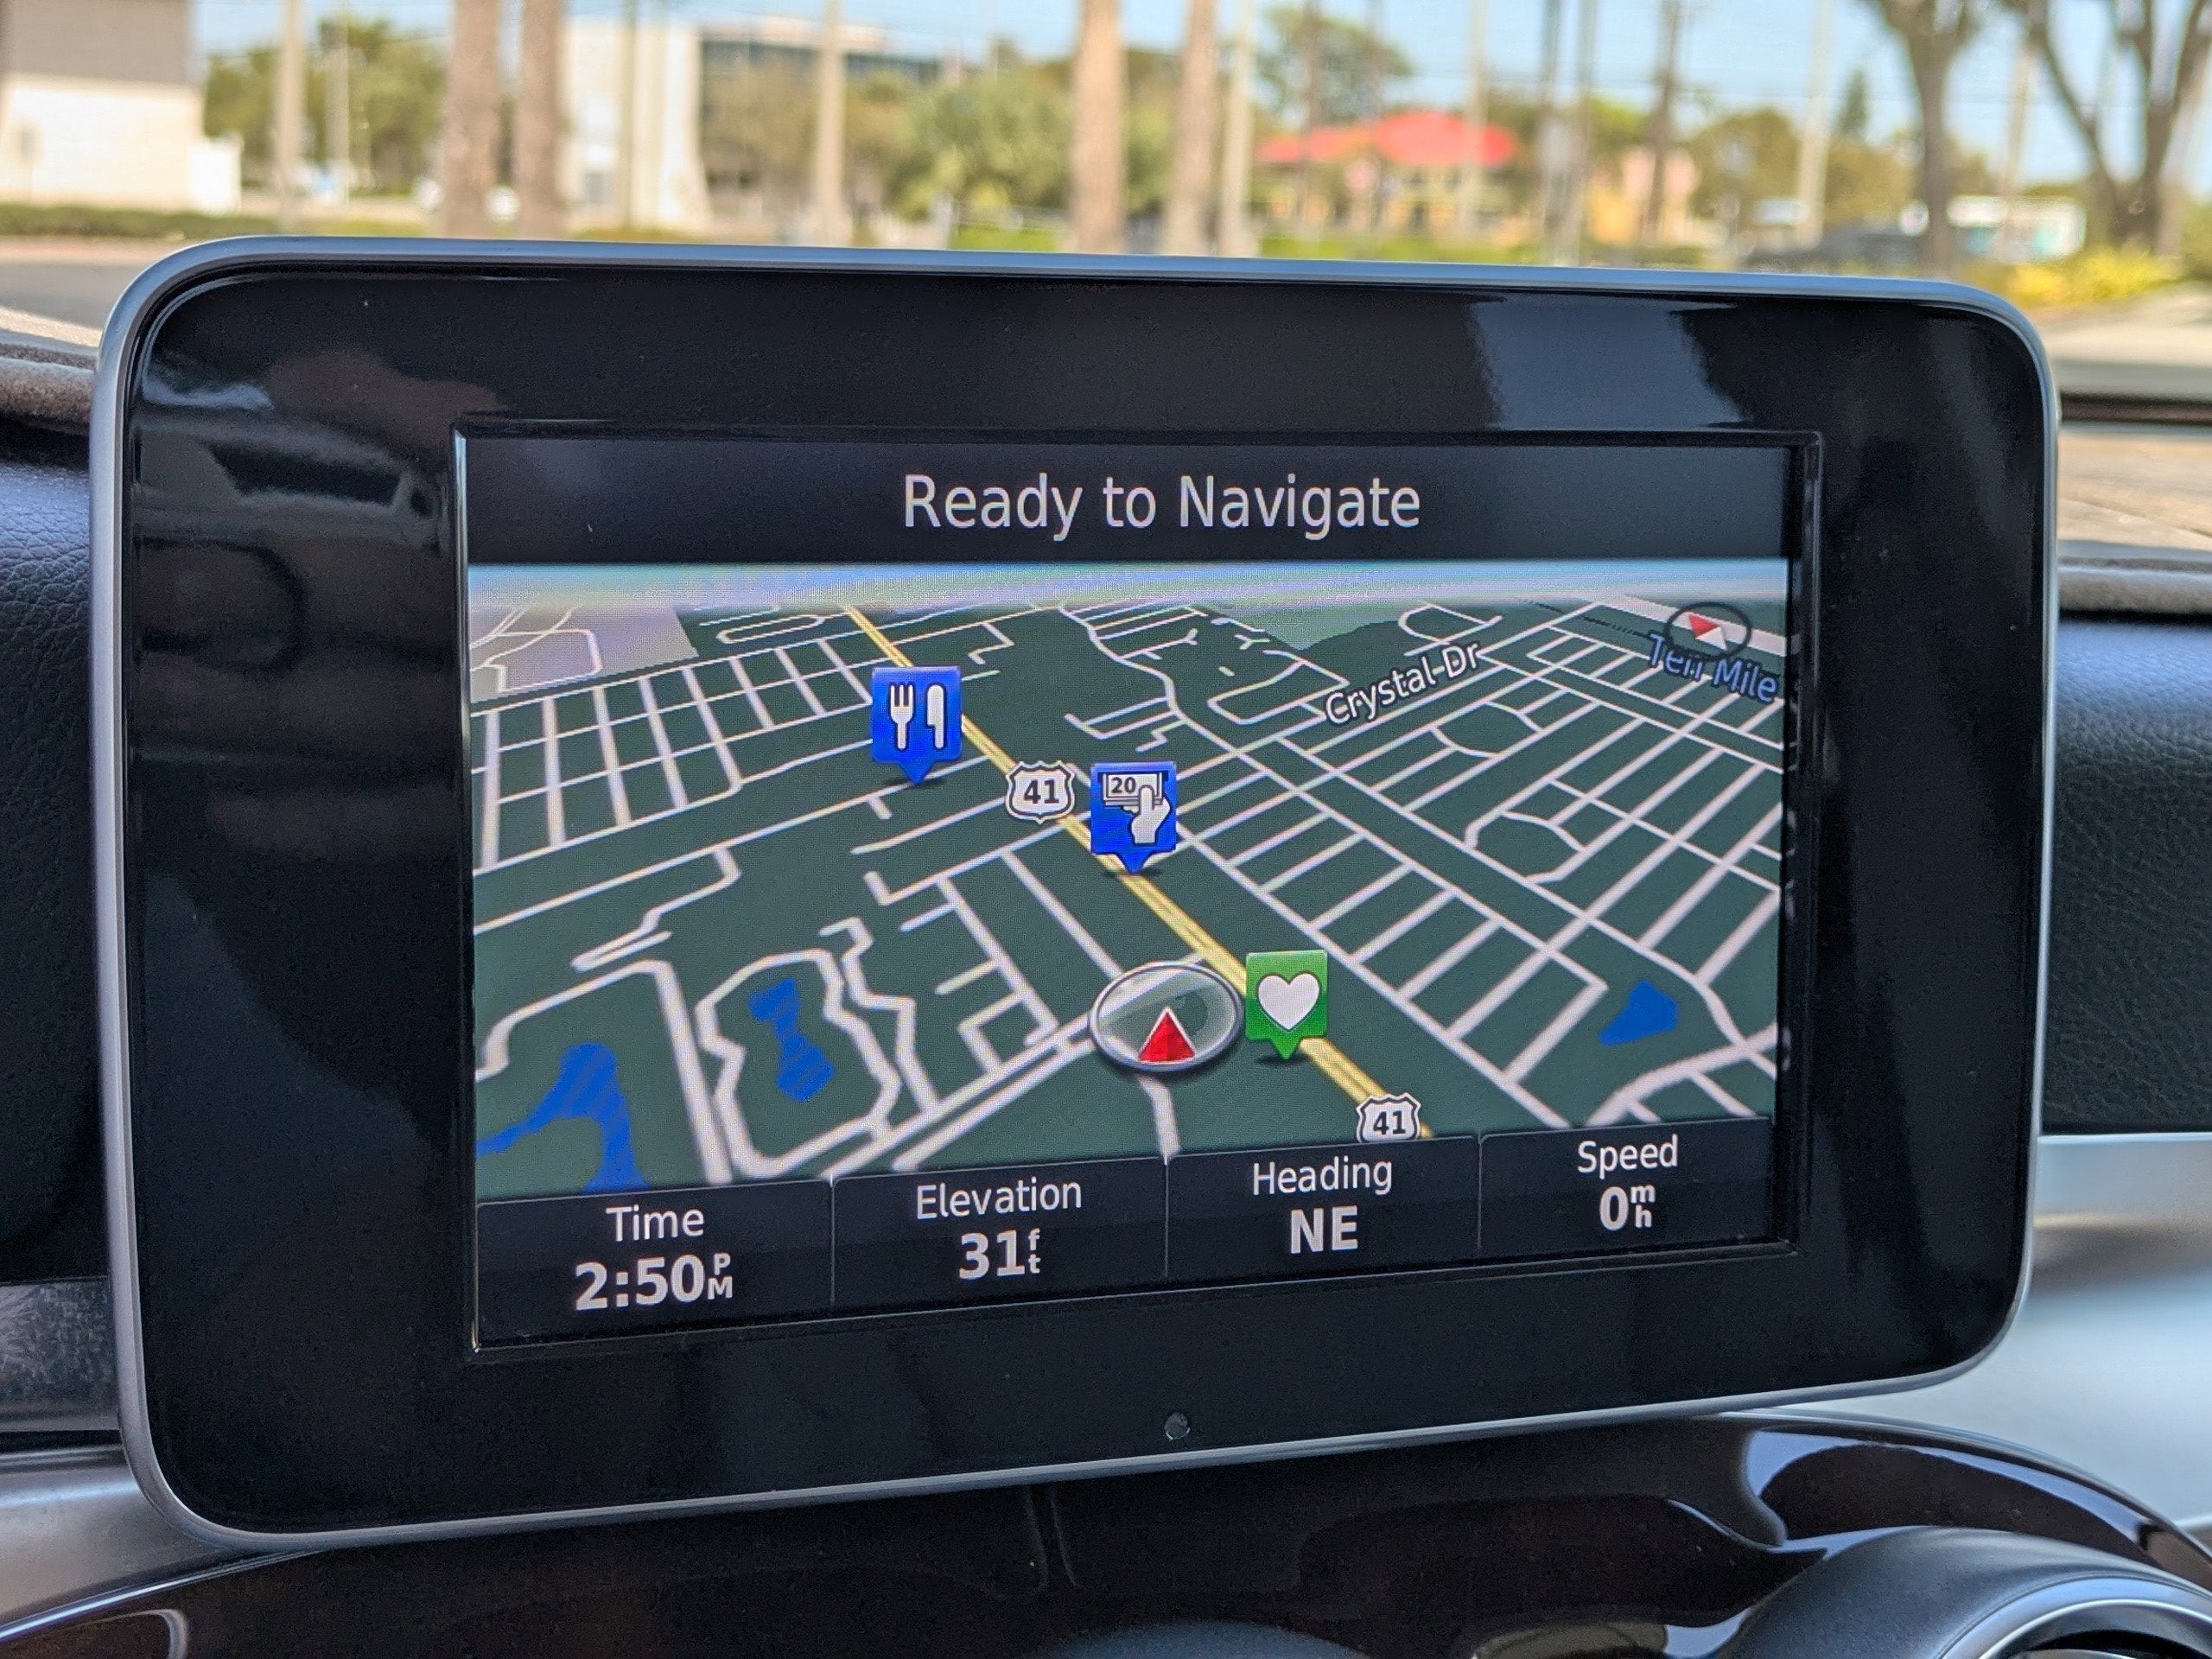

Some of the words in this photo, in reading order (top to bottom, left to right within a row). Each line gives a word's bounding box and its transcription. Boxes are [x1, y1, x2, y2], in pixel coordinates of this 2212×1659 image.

[903, 473, 1084, 543] Ready
[1103, 477, 1157, 528] to
[1179, 474, 1421, 541] Navigate
[1325, 658, 1437, 725] Crystal
[1442, 643, 1482, 679] Dr
[1713, 662, 1779, 704] Mile
[1023, 779, 1059, 804] 41
[1111, 777, 1136, 794] 20
[1373, 1109, 1406, 1135] 41
[1253, 1158, 1393, 1196] Heading
[1577, 1134, 1679, 1179] Speed
[916, 1178, 1083, 1220] Elevation
[606, 1205, 705, 1243] Time
[1289, 1205, 1359, 1254] NE
